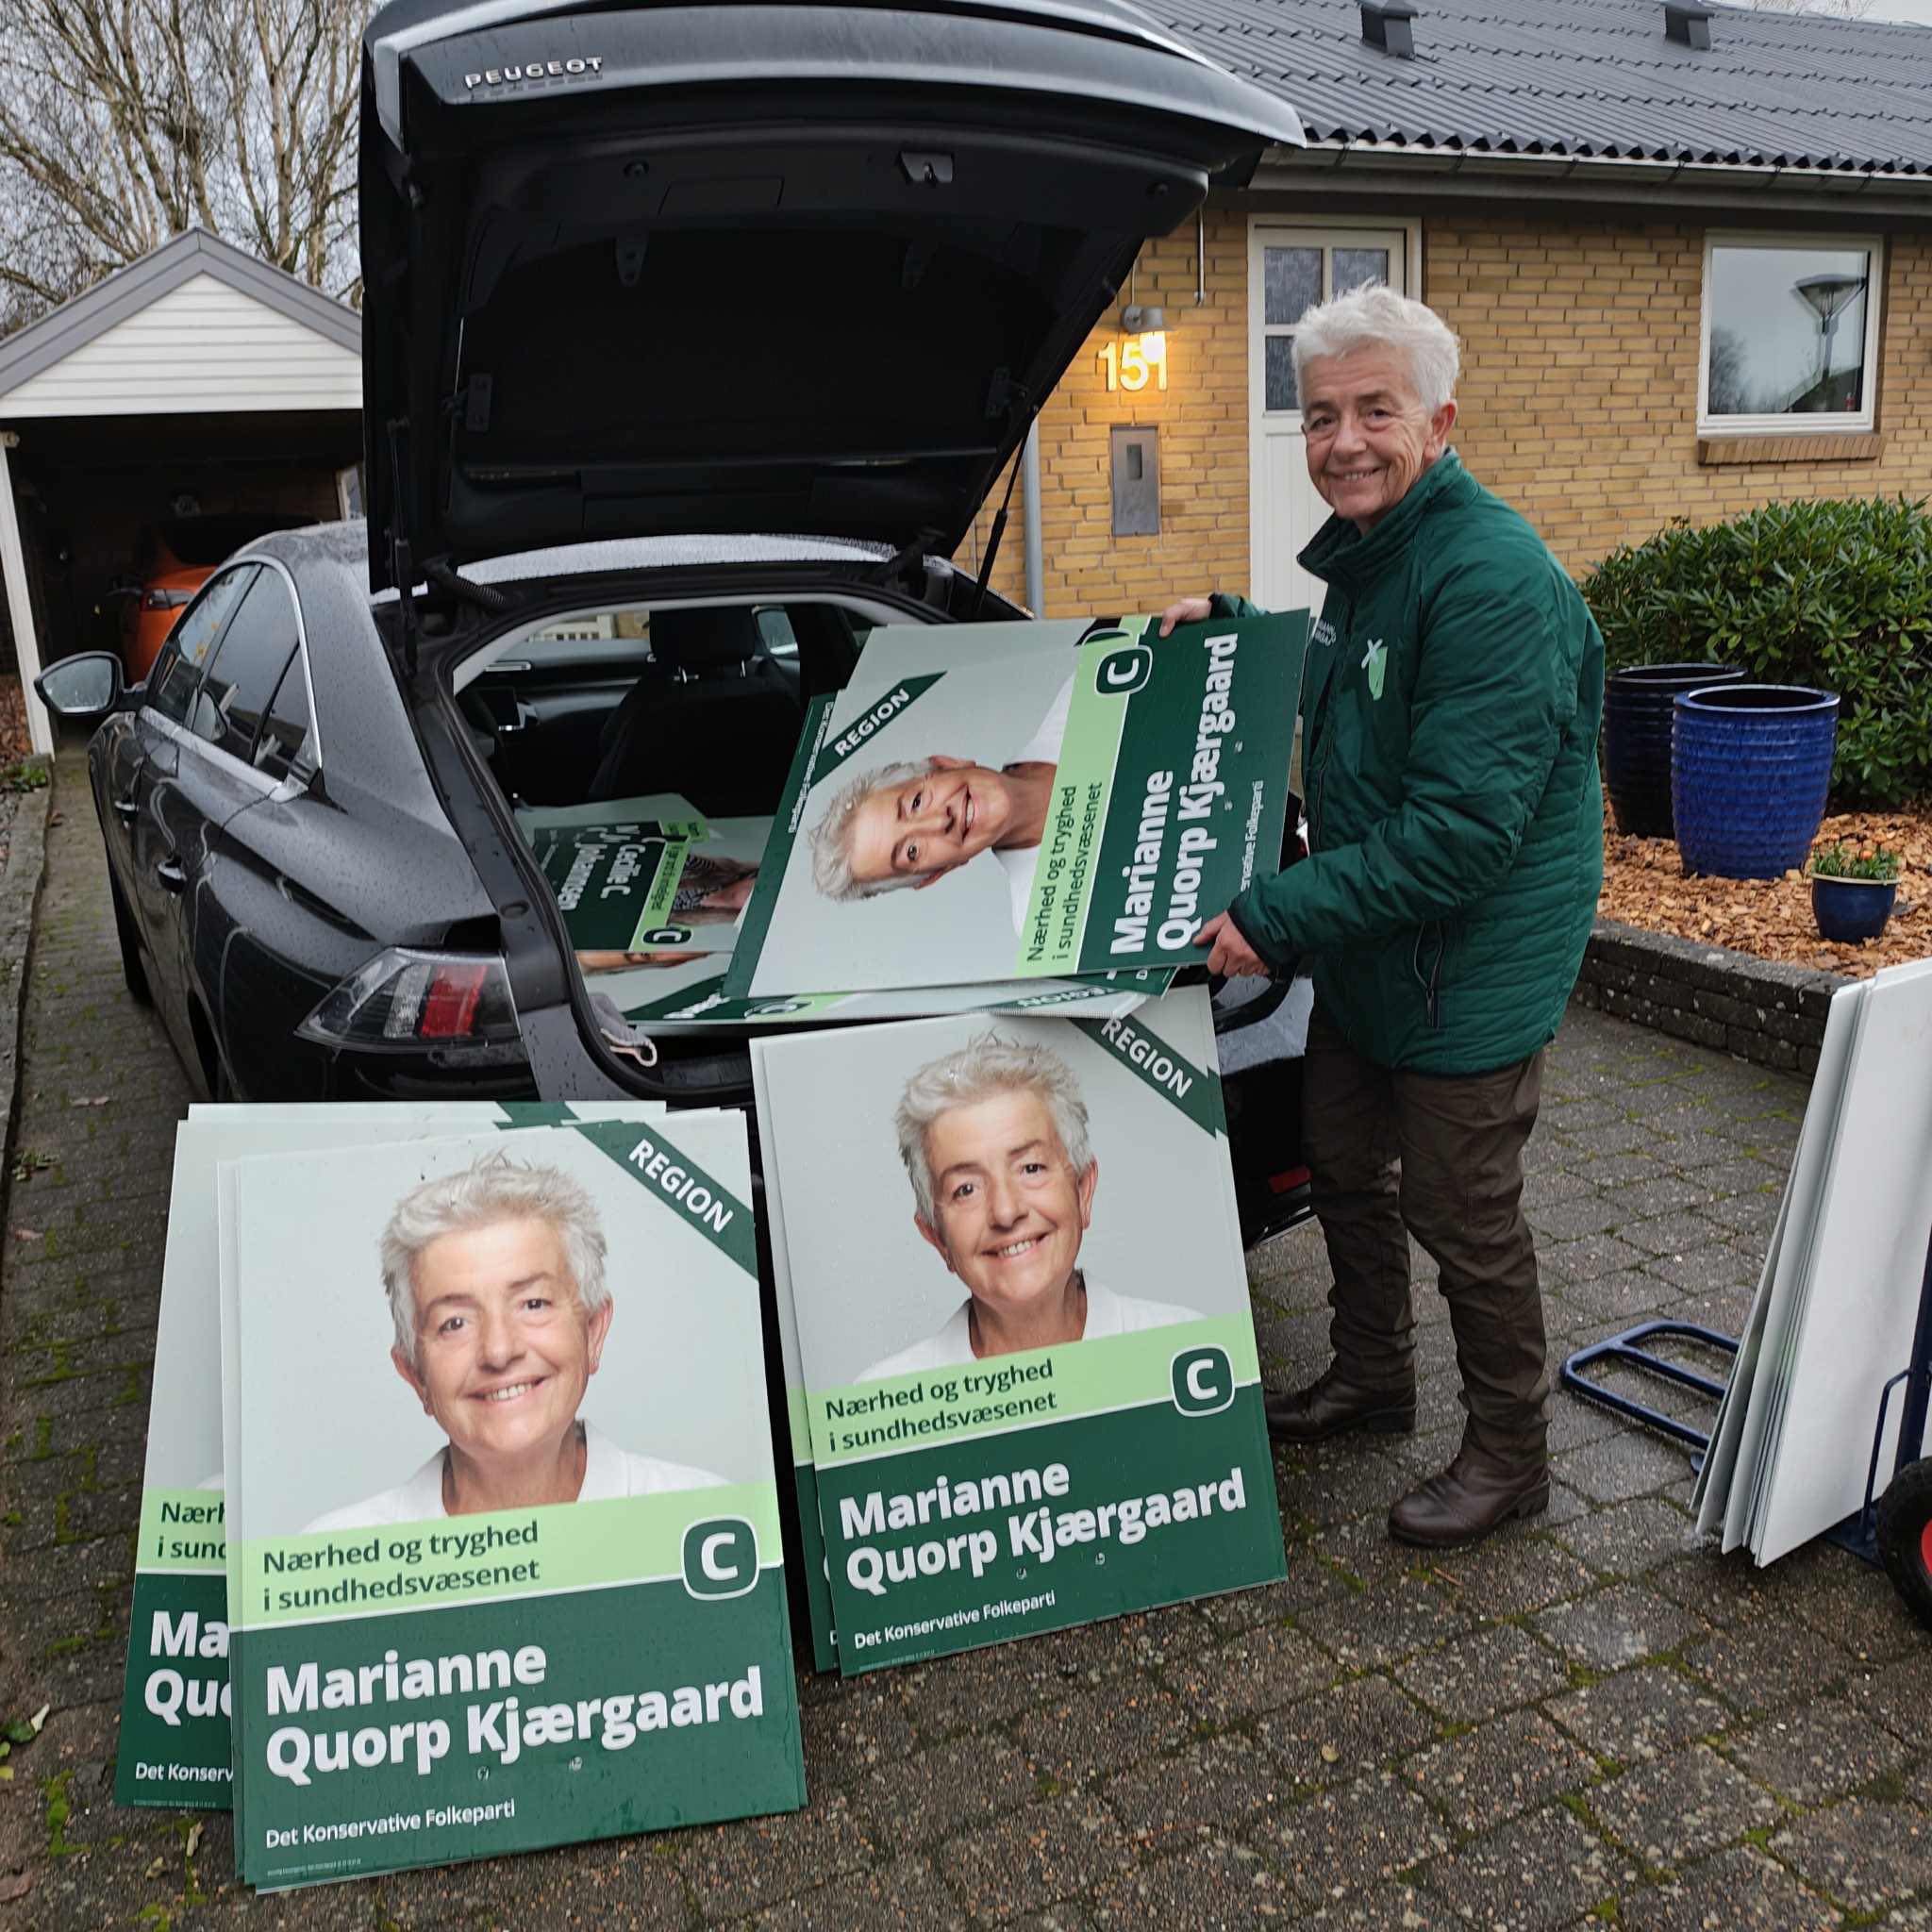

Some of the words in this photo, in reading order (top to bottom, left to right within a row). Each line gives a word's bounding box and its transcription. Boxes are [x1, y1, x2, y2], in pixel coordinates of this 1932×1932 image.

[465, 57, 603, 89] PEUGEOT
[1098, 336, 1167, 391] 151
[1107, 658, 1140, 685] C
[835, 688, 909, 757] REGION
[1177, 632, 1238, 821] Kjærgaard
[1052, 785, 1076, 856] tryghed
[1048, 858, 1066, 881] og
[1058, 782, 1102, 949] sundhedsvæsenet
[1110, 770, 1174, 955] Marianne
[1157, 826, 1217, 951] Quorp
[1027, 884, 1058, 961] Nærhed
[1101, 1017, 1192, 1099] REGION
[628, 1139, 734, 1234] REGION
[824, 1382, 924, 1420] Nærhed
[930, 1381, 958, 1401] og
[963, 1358, 1053, 1393] tryghed
[1186, 1358, 1218, 1400] C
[828, 1431, 836, 1452] i
[842, 1391, 1058, 1451] sundhedsvæsenet
[839, 1462, 1070, 1540] Marianne
[846, 1529, 997, 1596] Quorp
[1008, 1467, 1246, 1562] Kjærgaard
[158, 1536, 164, 1558] i
[263, 1538, 379, 1574] Nærhed
[389, 1539, 423, 1564] og
[429, 1520, 539, 1560] tryghed
[701, 1532, 738, 1580] C
[263, 1588, 271, 1611] i
[278, 1559, 541, 1610] sundhedsvæsenet
[854, 1631, 882, 1650] Det
[884, 1607, 980, 1642] Konservative
[983, 1590, 1056, 1622] Folkeparti
[266, 1644, 546, 1715] Marianne
[266, 1718, 451, 1785] Quorp
[466, 1665, 763, 1764] Kjærgaard
[135, 1762, 165, 1781] Det
[168, 1762, 233, 1783] Konserv
[266, 1828, 299, 1849] Det
[303, 1812, 421, 1844] Konservative
[425, 1798, 516, 1828] Folkeparti
